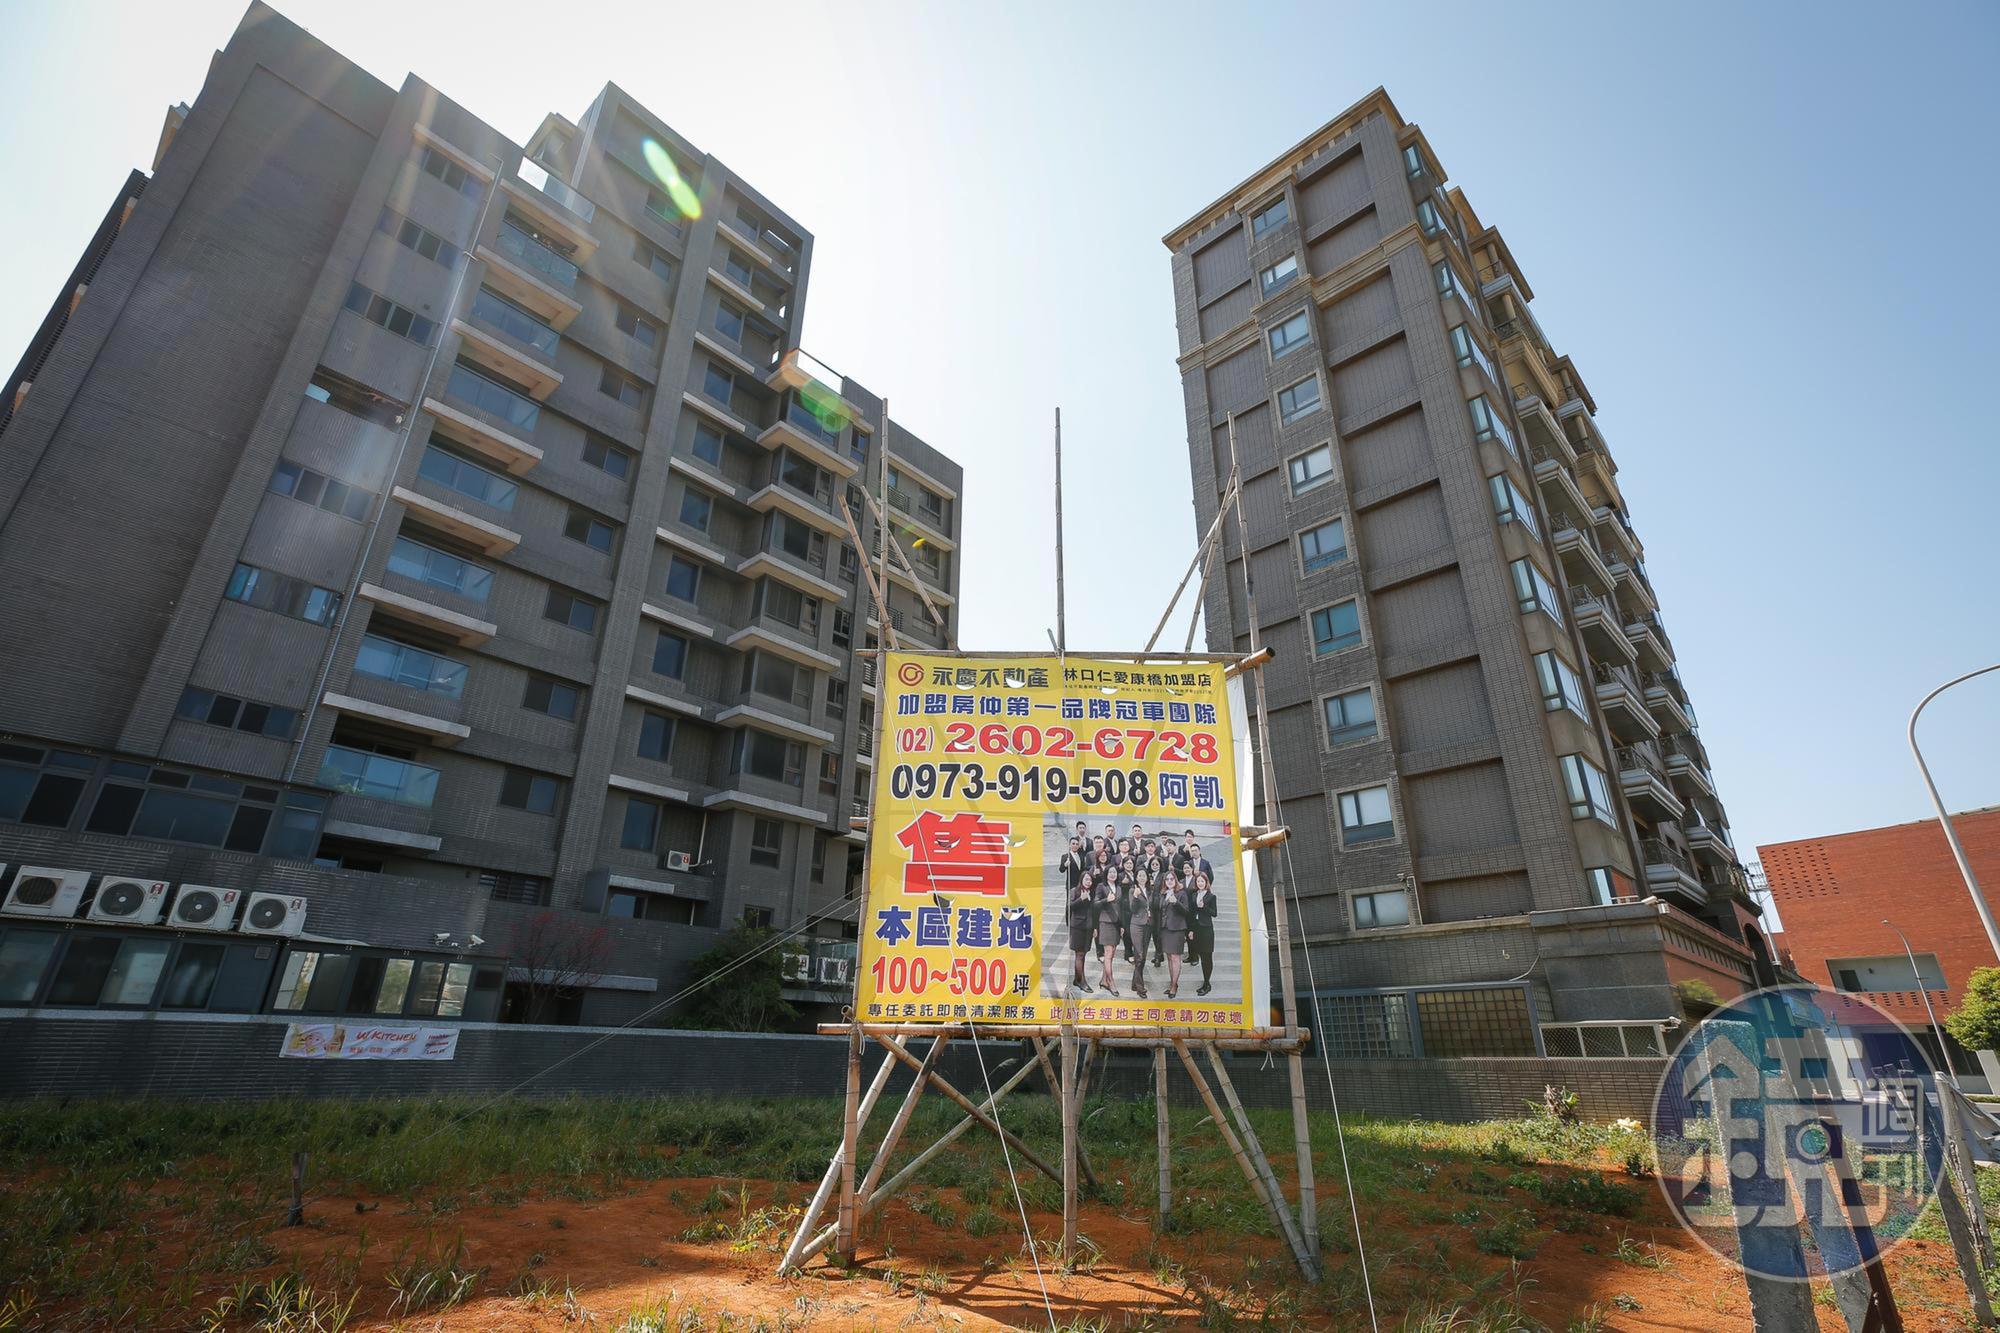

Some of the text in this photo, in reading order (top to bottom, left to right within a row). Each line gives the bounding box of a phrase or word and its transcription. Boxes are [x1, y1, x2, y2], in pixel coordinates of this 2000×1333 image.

[933, 666, 1212, 688] 永慶不動產 林口仁愛康橋加盟店
[898, 694, 1216, 724] 加盟房仲第一品牌冠軍團隊
[896, 722, 1219, 764] (02) 2602-6728
[892, 763, 1224, 809] 0973-919-508 阿凱
[897, 810, 1011, 897] 售
[876, 906, 1033, 949] 本區建地
